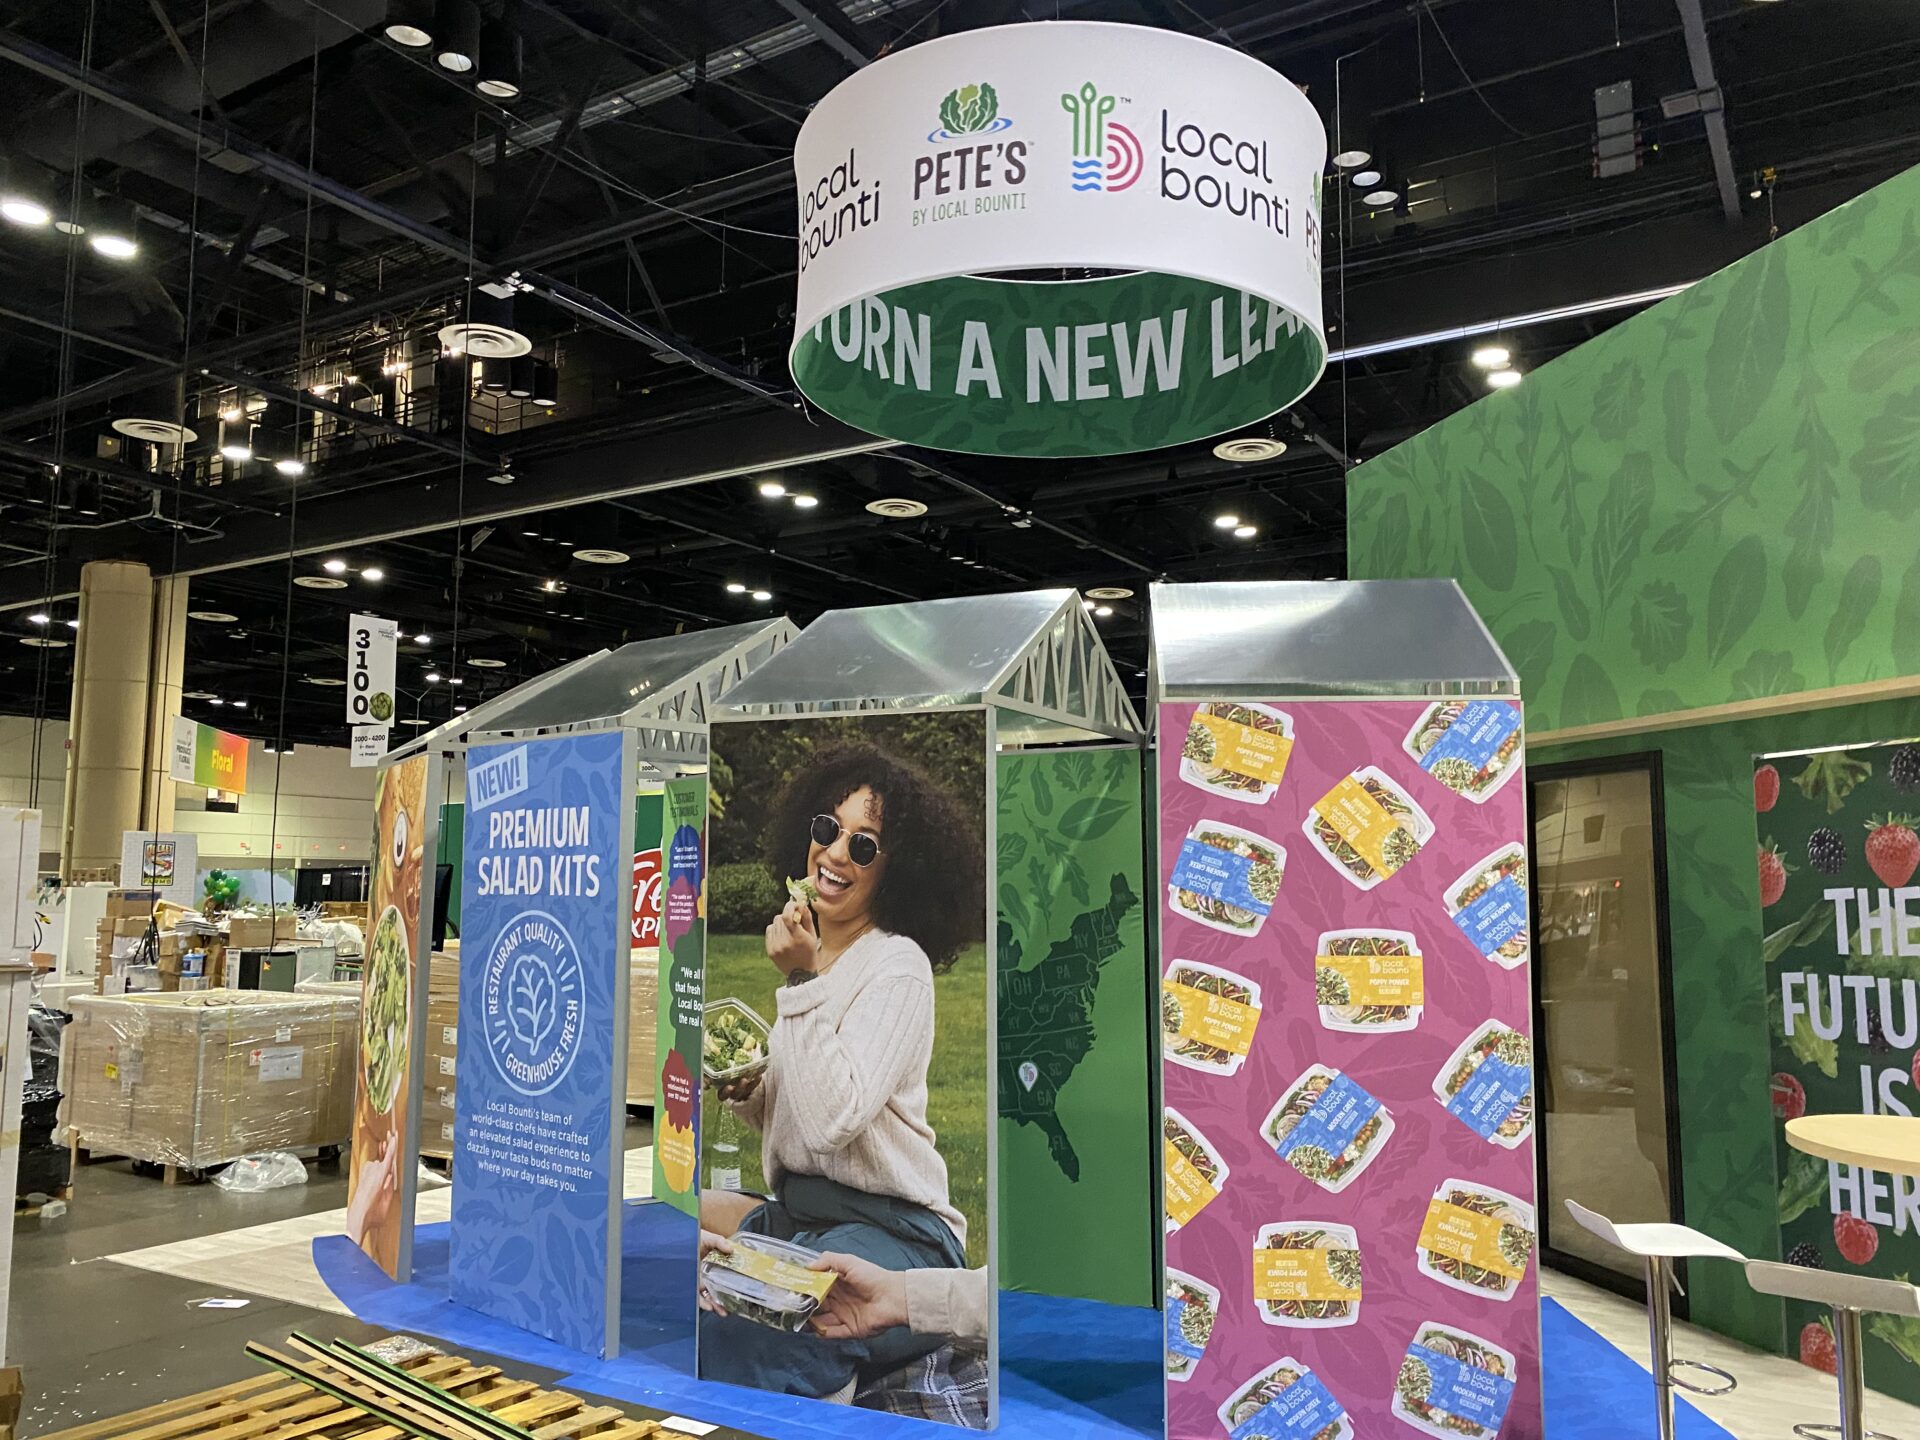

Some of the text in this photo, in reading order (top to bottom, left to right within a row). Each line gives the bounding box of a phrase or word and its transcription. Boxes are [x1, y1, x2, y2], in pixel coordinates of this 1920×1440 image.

[1162, 109, 1273, 184] local
[913, 141, 1027, 200] PETE'S
[802, 148, 860, 233] local
[1161, 156, 1289, 238] bounti
[801, 180, 881, 273] bounti
[912, 193, 1027, 227] BY LOCAL BOUNTI
[815, 295, 931, 391] URN
[955, 320, 1003, 398] A
[1025, 308, 1188, 403] NEW
[353, 629, 371, 715] 3100
[1463, 704, 1480, 722] local
[211, 750, 234, 773] Floral
[476, 755, 521, 802] NEW!
[489, 806, 590, 849] PREMIUM
[477, 854, 600, 897] SALAD KITS
[1823, 886, 1920, 956] THE
[488, 922, 565, 1015] RESTAURANT QUALITY
[1056, 964, 1070, 979] PA
[675, 981, 701, 995] that fresh
[677, 997, 692, 1010] Local
[1013, 977, 1032, 996] OH
[679, 1013, 700, 1027] the real
[505, 1000, 578, 1083] GREENHOUSE FRESH
[1048, 1063, 1061, 1077] SC
[1037, 1090, 1053, 1106] GA
[1319, 1089, 1338, 1108] local
[1860, 1064, 1913, 1117] IS
[471, 1113, 589, 1145] world-class chefs have crafted
[486, 1099, 573, 1126] Local Bounti's team of
[469, 1128, 591, 1162] an elevated salad experience to
[1053, 1135, 1064, 1150] FL
[466, 1141, 593, 1179] dazzle your taste buds no matter
[477, 1160, 578, 1193] where your day takes you.
[1283, 1385, 1303, 1403] local
[1473, 1371, 1495, 1386] local
